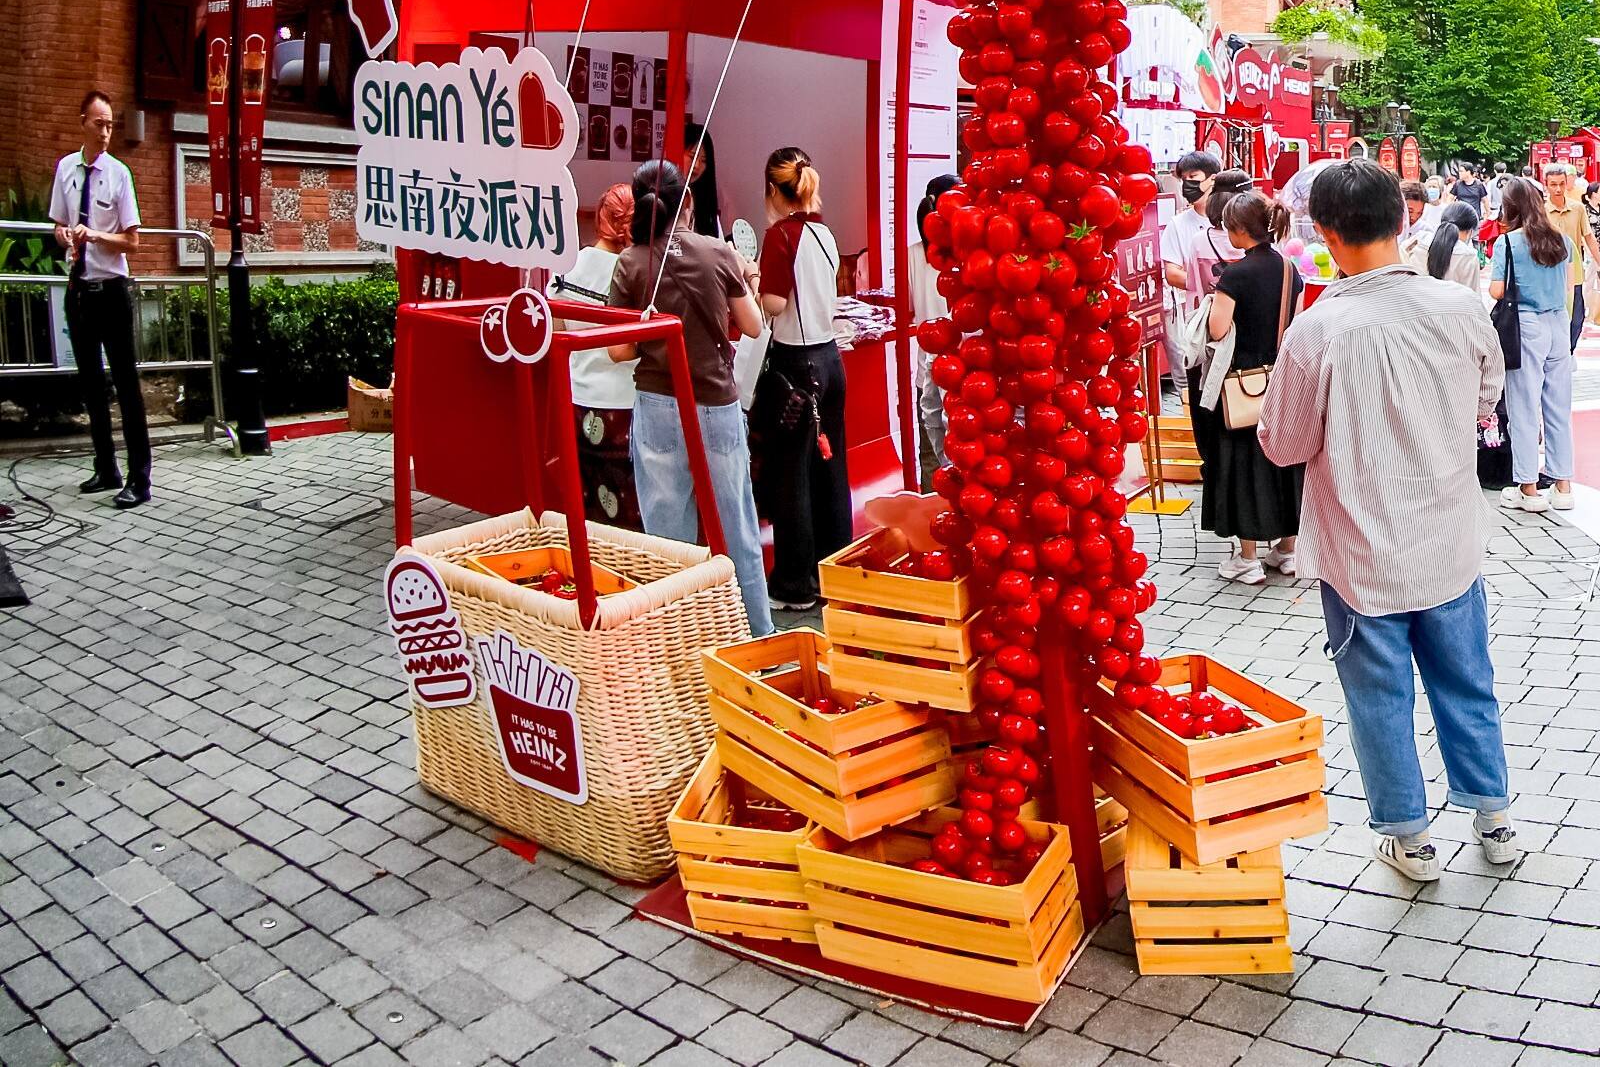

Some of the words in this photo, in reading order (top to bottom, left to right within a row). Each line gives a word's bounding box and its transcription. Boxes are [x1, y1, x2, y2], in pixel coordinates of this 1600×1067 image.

[365, 165, 565, 255] 思南夜派对
[511, 714, 518, 724] IT
[520, 717, 535, 731] HAS
[536, 723, 546, 735] TO
[548, 728, 558, 739] BE
[509, 731, 567, 772] HEINZ
